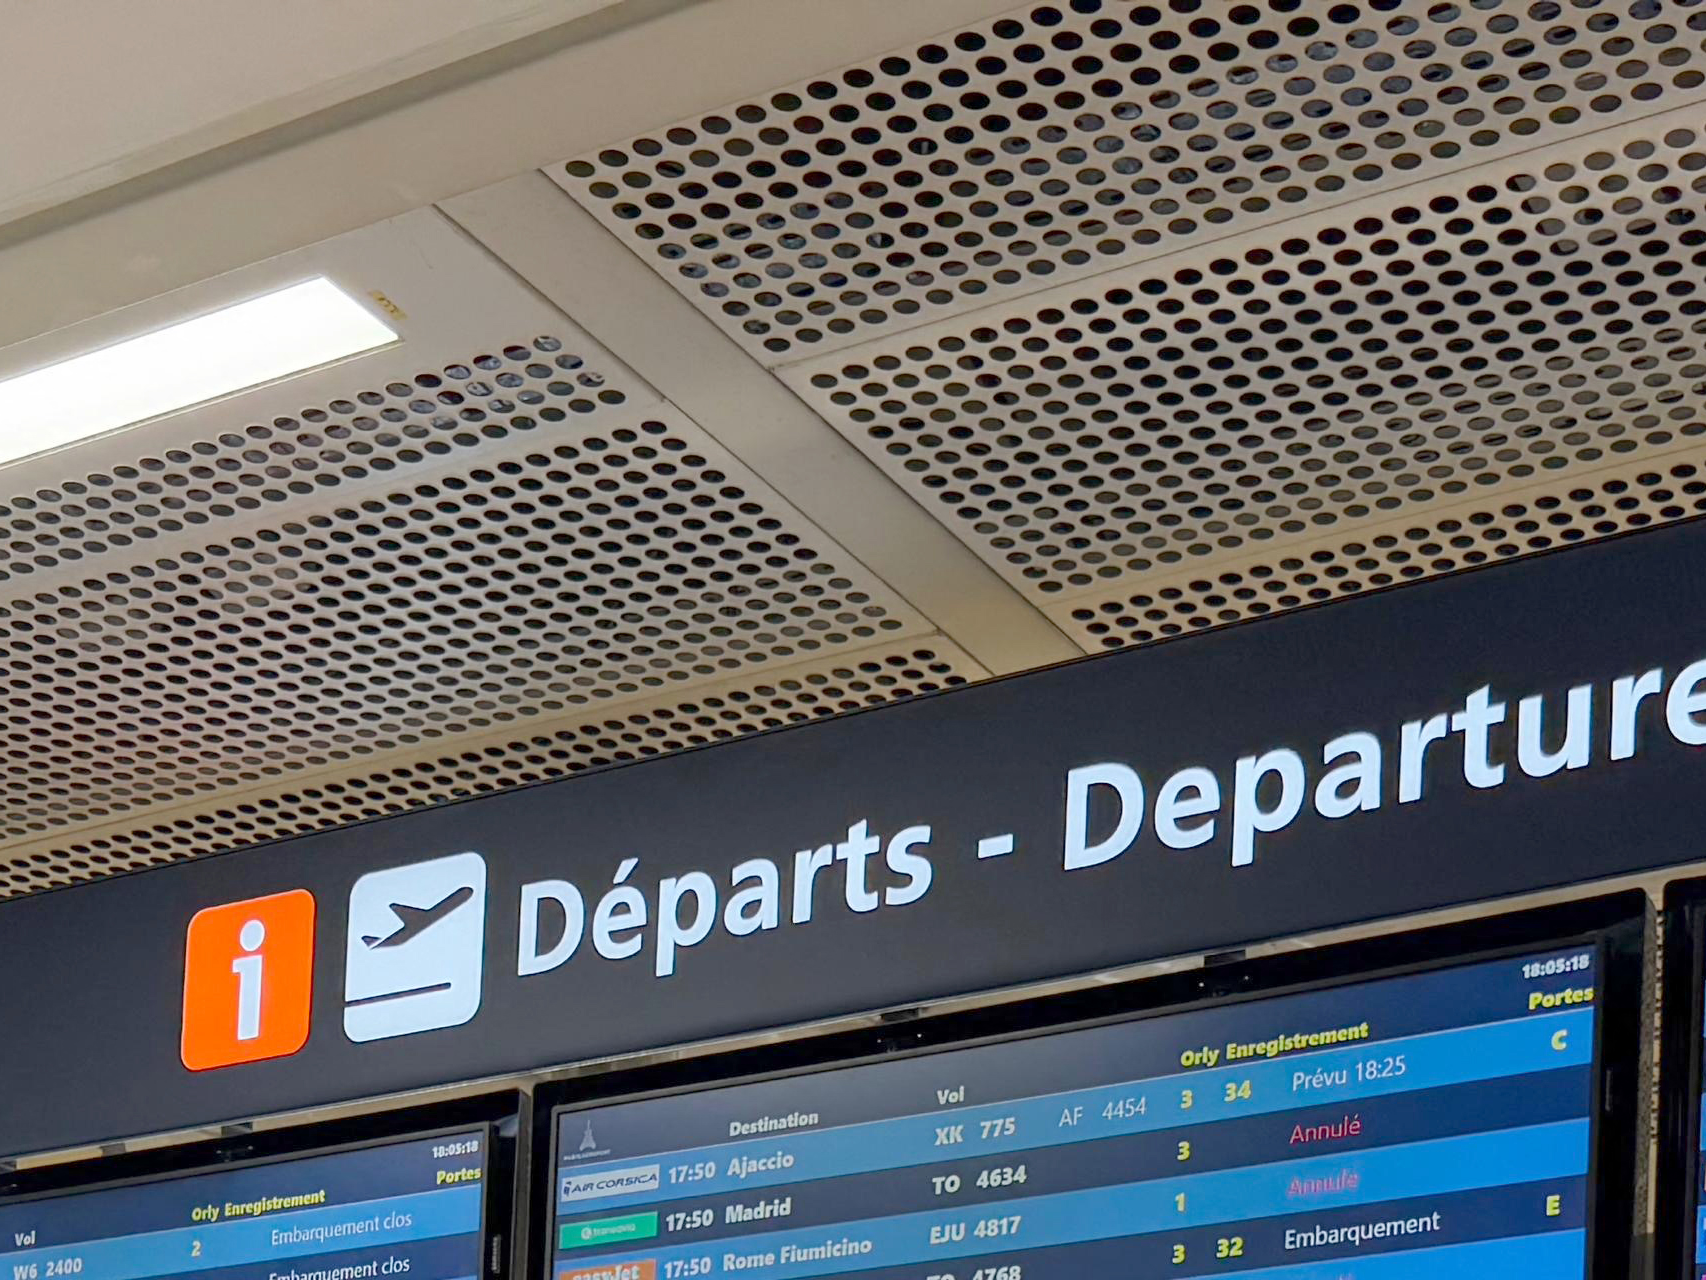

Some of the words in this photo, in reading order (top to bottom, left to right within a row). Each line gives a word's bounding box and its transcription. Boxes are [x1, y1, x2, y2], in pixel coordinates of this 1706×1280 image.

[517, 818, 933, 977] Départs
[669, 1161, 716, 1184] 17:50
[726, 1150, 794, 1178] Ajaccio
[934, 1125, 963, 1146] XK
[980, 1116, 1016, 1139] 775
[1058, 1106, 1083, 1127] AF
[1102, 1096, 1146, 1120] 4454
[1180, 1089, 1193, 1109] 3
[1224, 1080, 1252, 1102] 34
[1292, 1067, 1348, 1092] Prévu
[1355, 1054, 1406, 1082] 18:25
[1551, 1029, 1568, 1051] C
